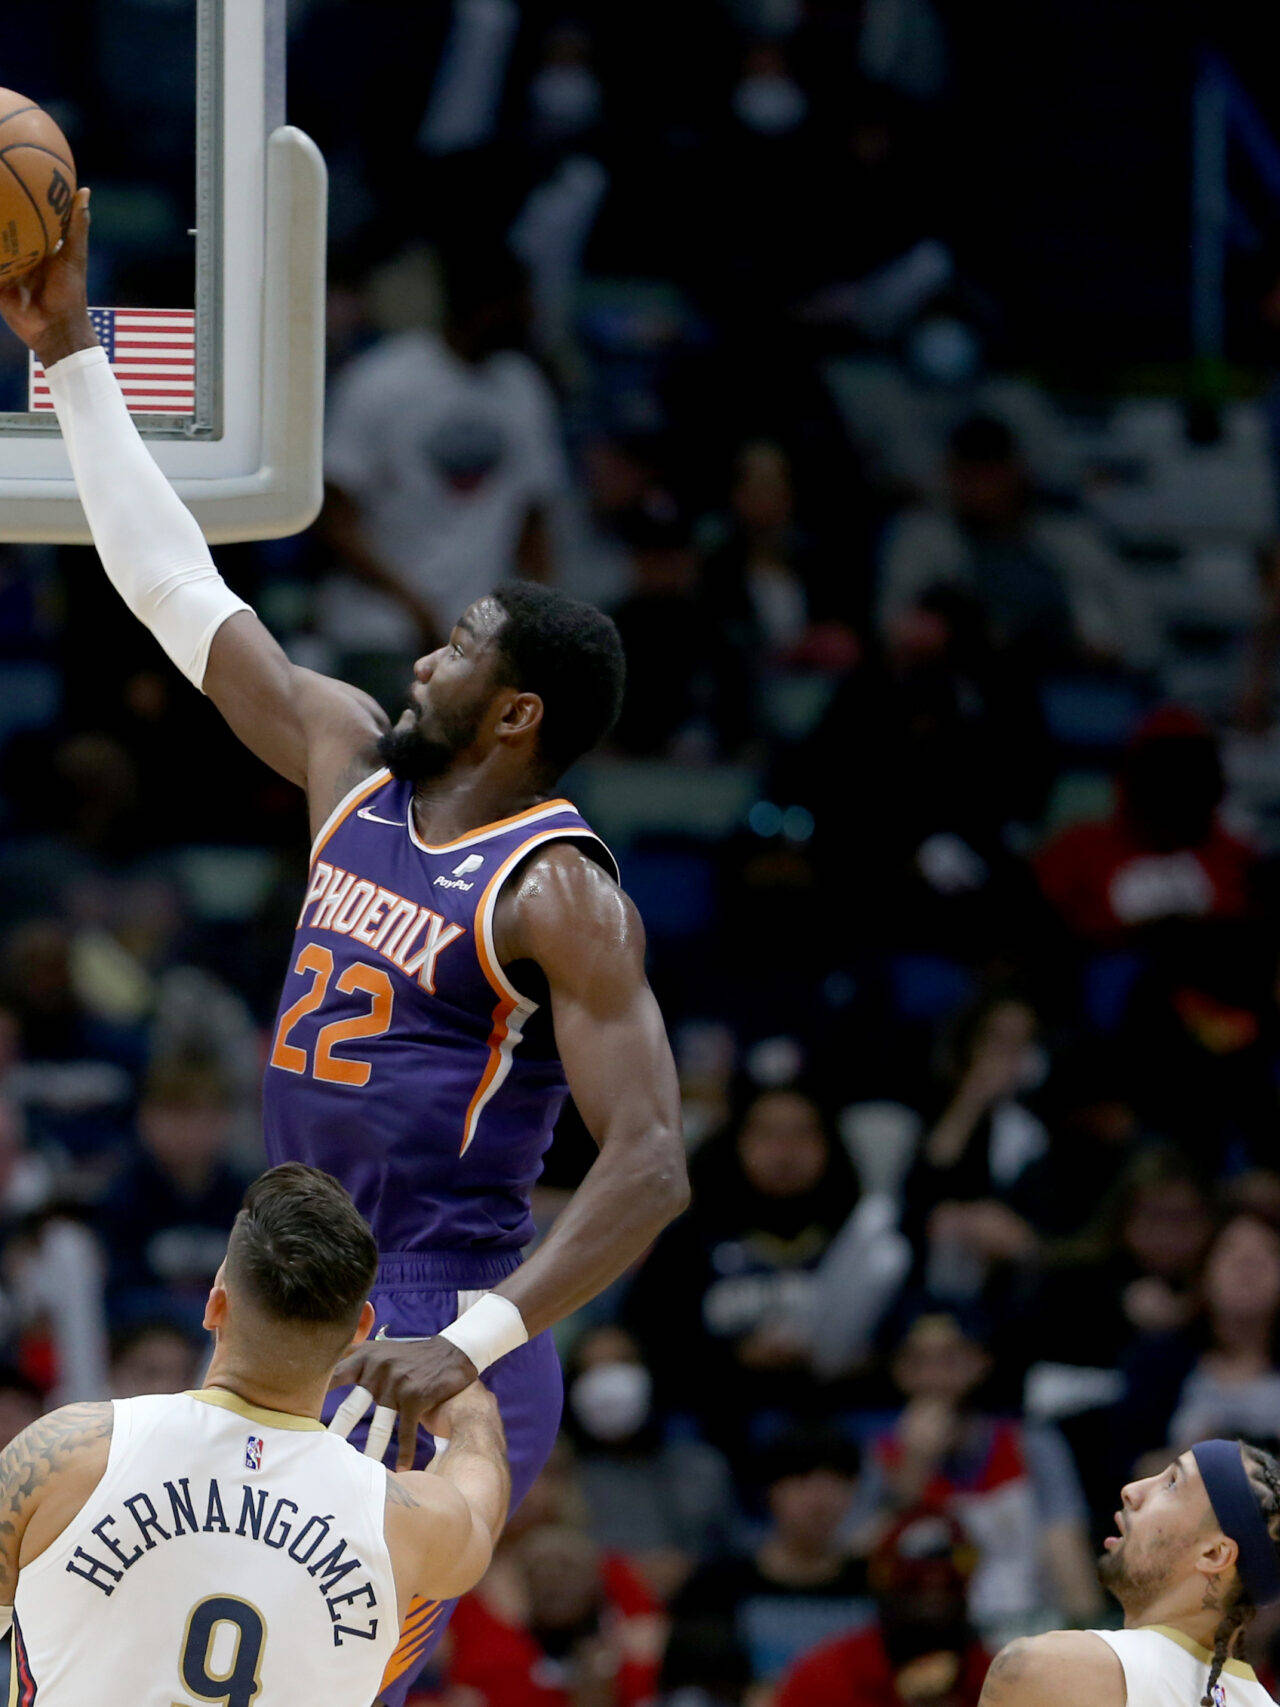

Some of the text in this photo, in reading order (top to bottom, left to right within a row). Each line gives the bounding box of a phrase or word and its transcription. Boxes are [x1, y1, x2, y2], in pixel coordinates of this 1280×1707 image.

[296, 860, 467, 995] PHOENIX
[433, 875, 474, 891] PayPal
[270, 942, 394, 1087] 22
[65, 1477, 378, 1647] HERNANGÓMEZ
[171, 1592, 268, 1707] 9
